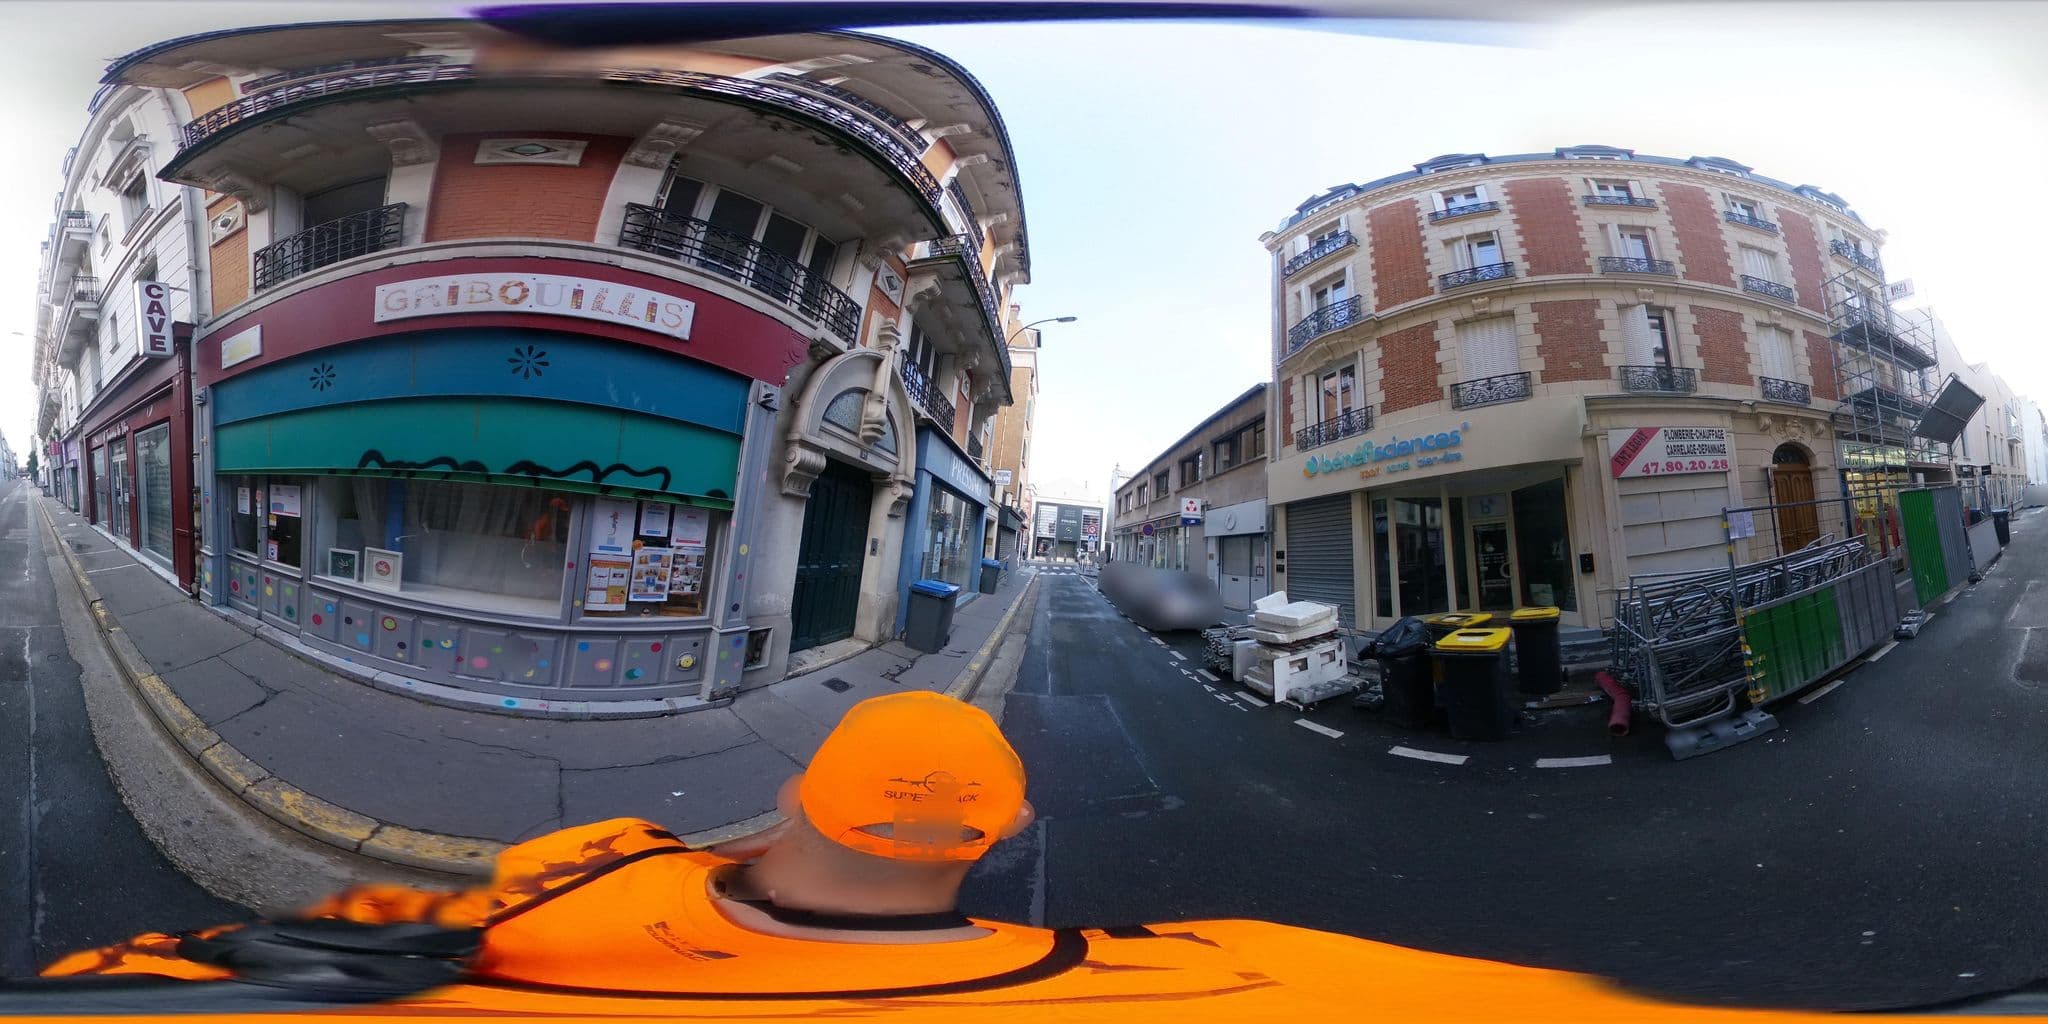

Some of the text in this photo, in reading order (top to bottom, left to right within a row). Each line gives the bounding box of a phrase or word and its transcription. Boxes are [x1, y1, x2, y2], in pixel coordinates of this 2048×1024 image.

[145, 284, 167, 352] CAVE
[1664, 429, 1725, 441] PLOMBERIE-CHAUFFAGE
[1666, 444, 1727, 456] CARRELAGE-DEPANNAGE
[1641, 459, 1729, 475] 47.80.20.28
[1168, 660, 1249, 712] PAYANT
